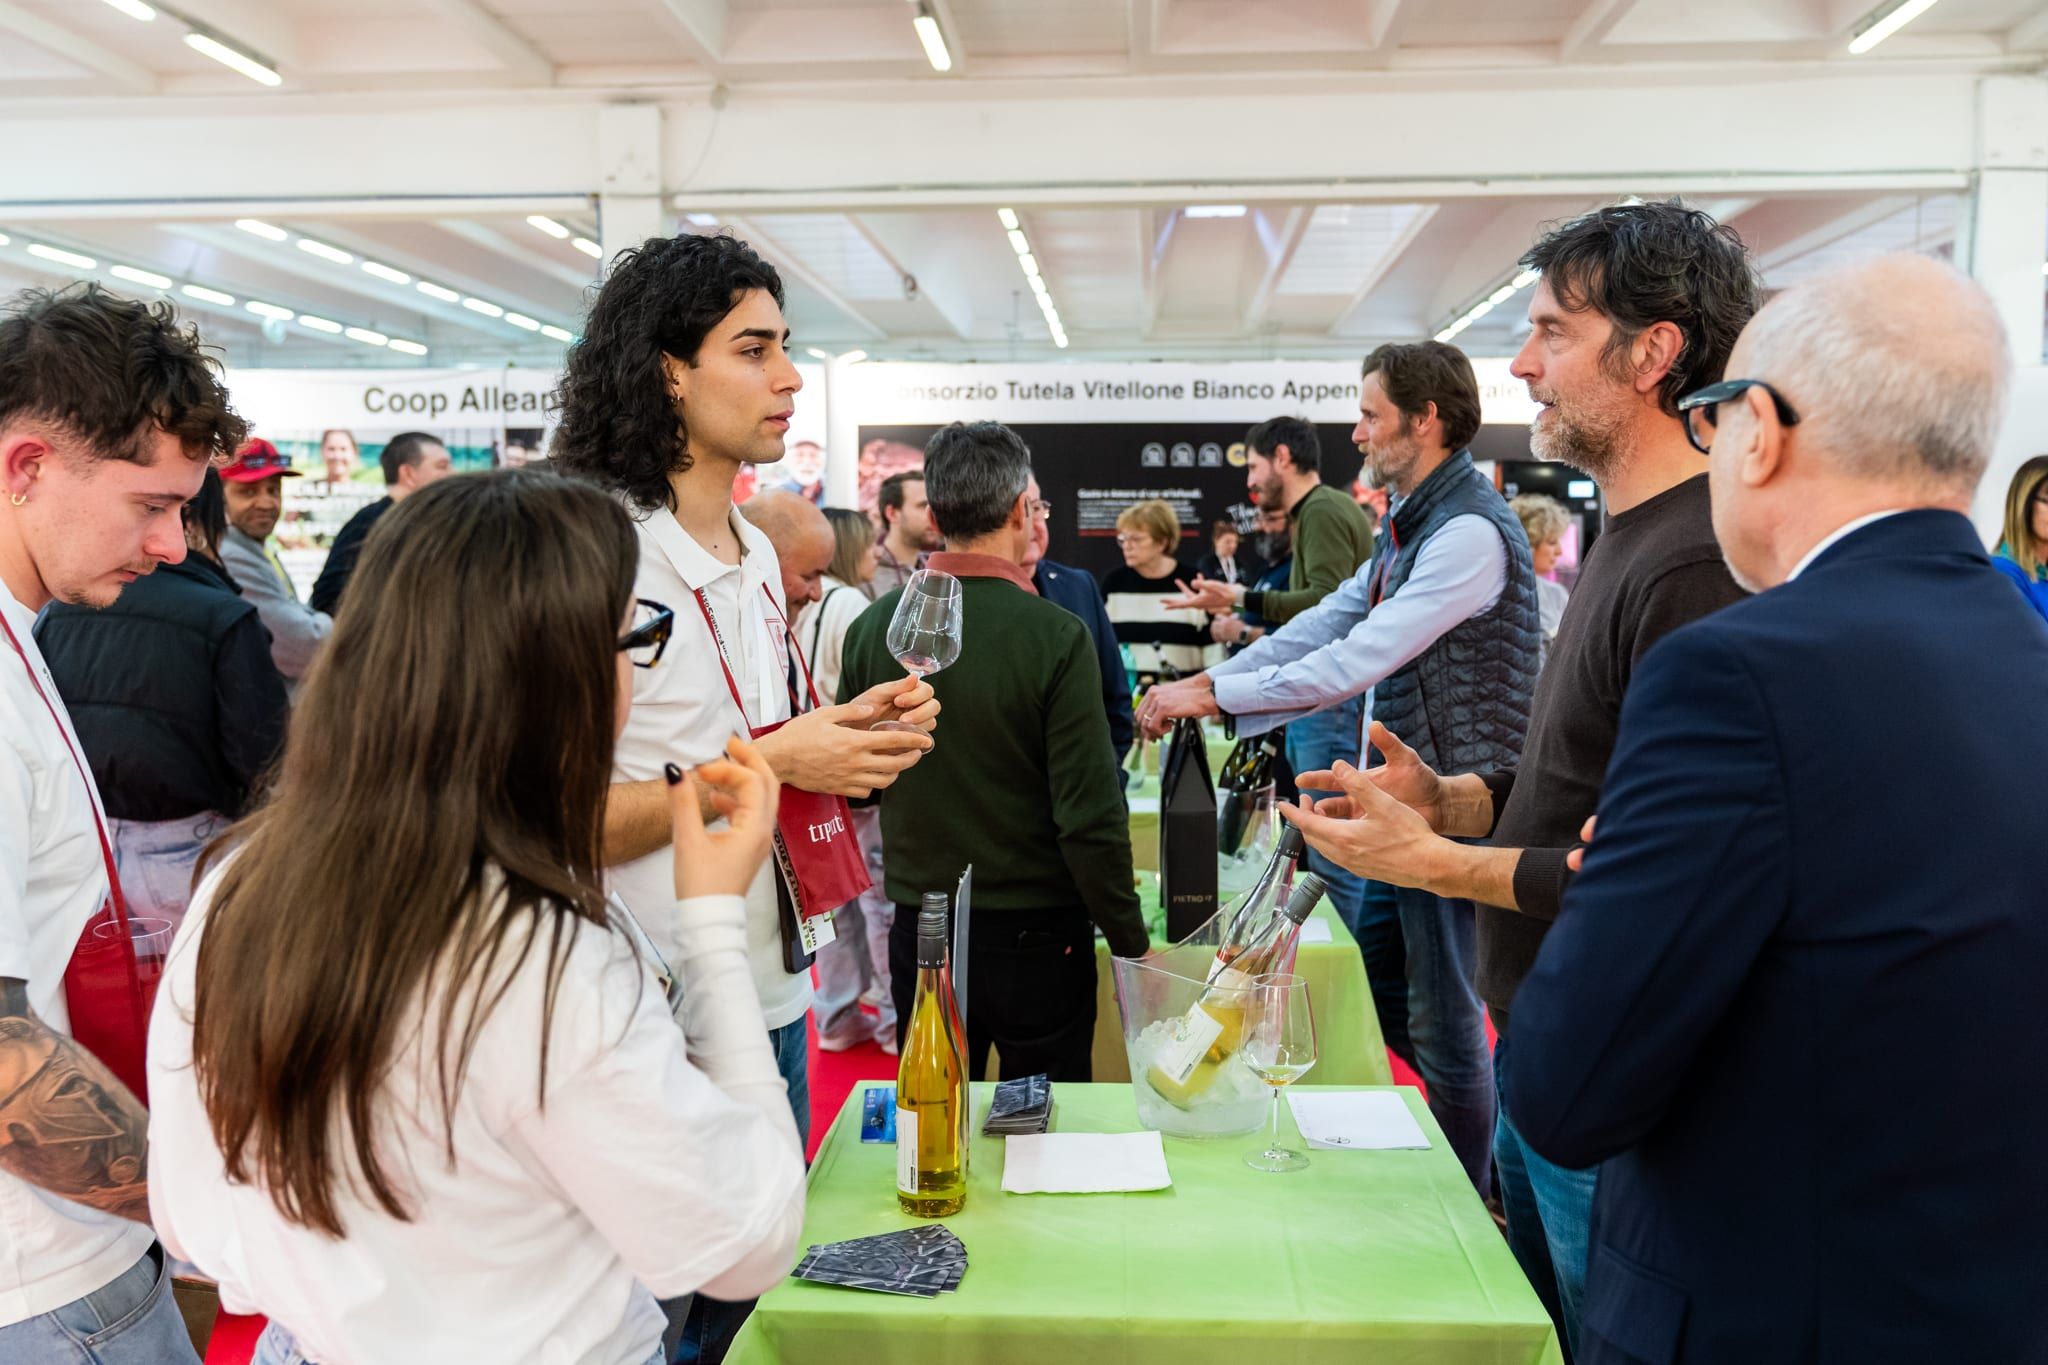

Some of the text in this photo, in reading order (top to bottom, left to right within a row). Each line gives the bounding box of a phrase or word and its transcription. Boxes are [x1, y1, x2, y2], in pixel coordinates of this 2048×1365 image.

[364, 387, 448, 419] Coop
[897, 381, 998, 400] onsorzio
[1006, 381, 1075, 400] Tutela
[1084, 380, 1185, 399] Vitellone
[1193, 380, 1275, 399] Bianco
